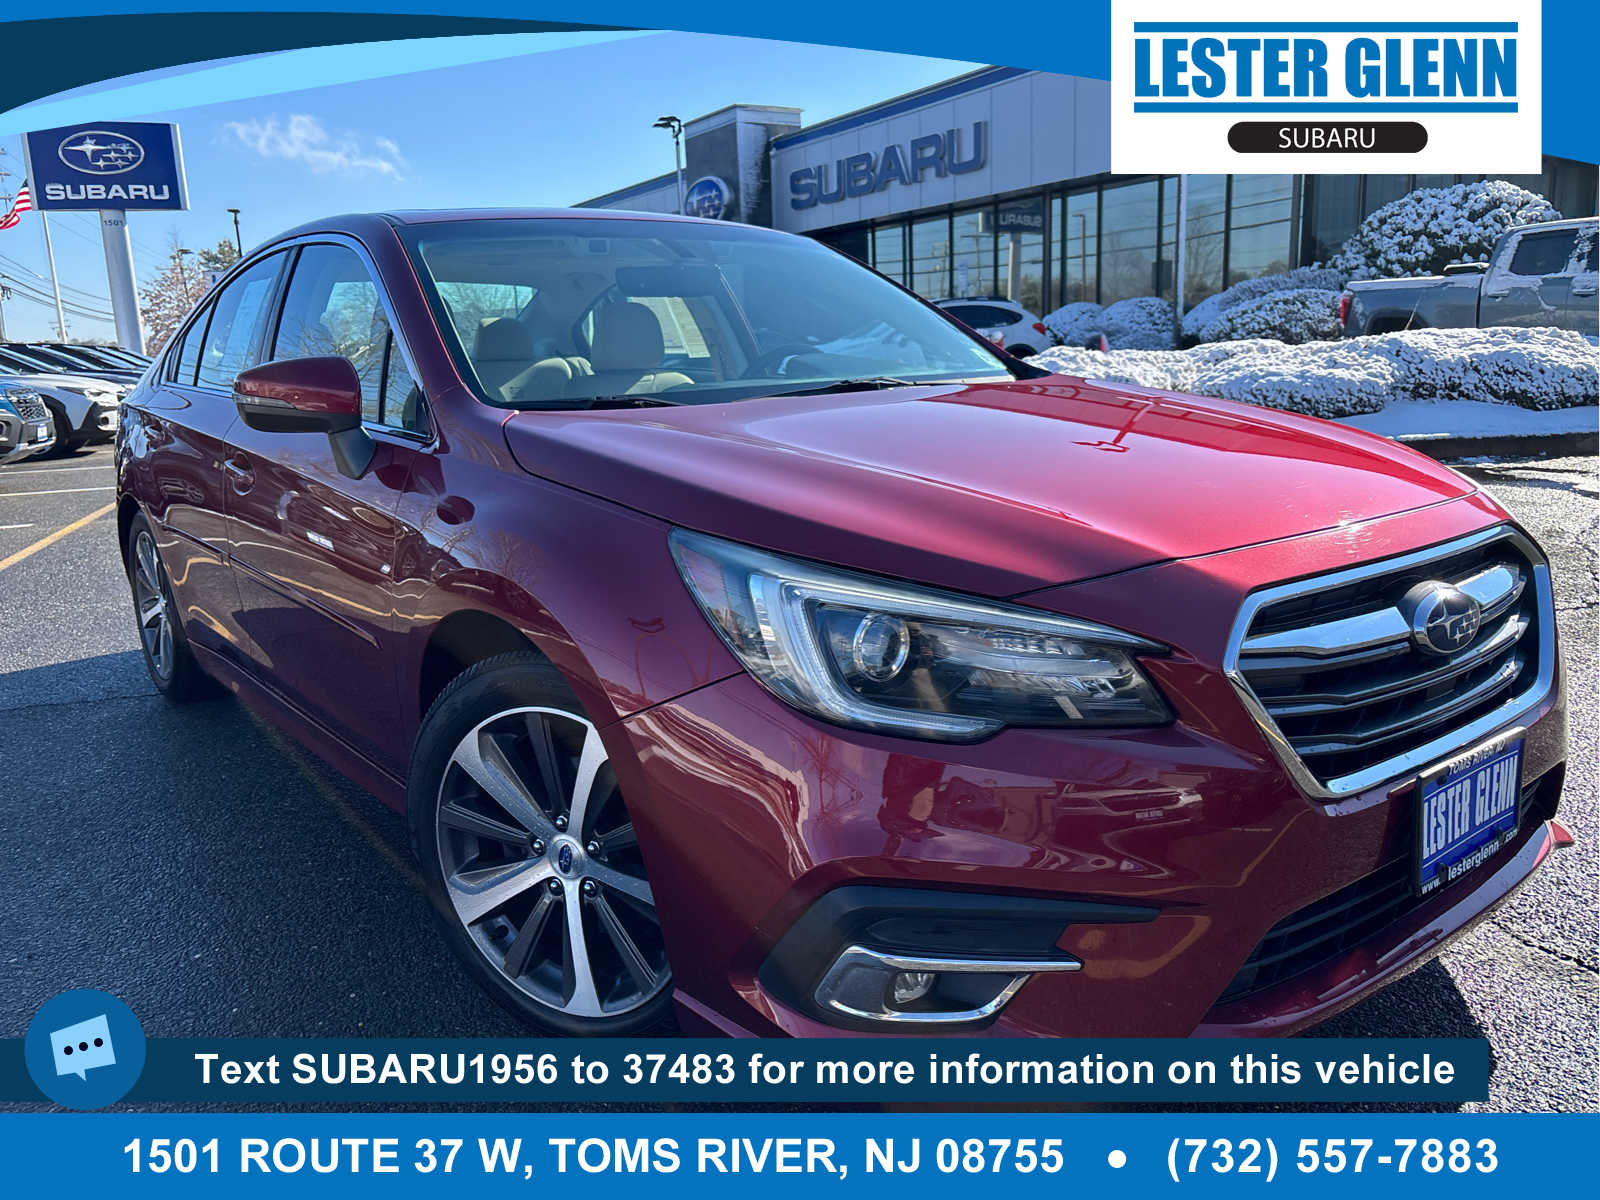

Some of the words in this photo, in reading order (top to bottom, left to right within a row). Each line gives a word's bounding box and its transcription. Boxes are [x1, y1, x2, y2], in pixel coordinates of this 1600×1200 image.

[789, 120, 988, 211] SUBARU
[45, 183, 170, 201] SUBARU
[1449, 757, 1472, 776] TOMS
[1423, 778, 1471, 860] LESTER
[1475, 754, 1519, 827] GLENN
[1447, 839, 1499, 881] lesterglenn
